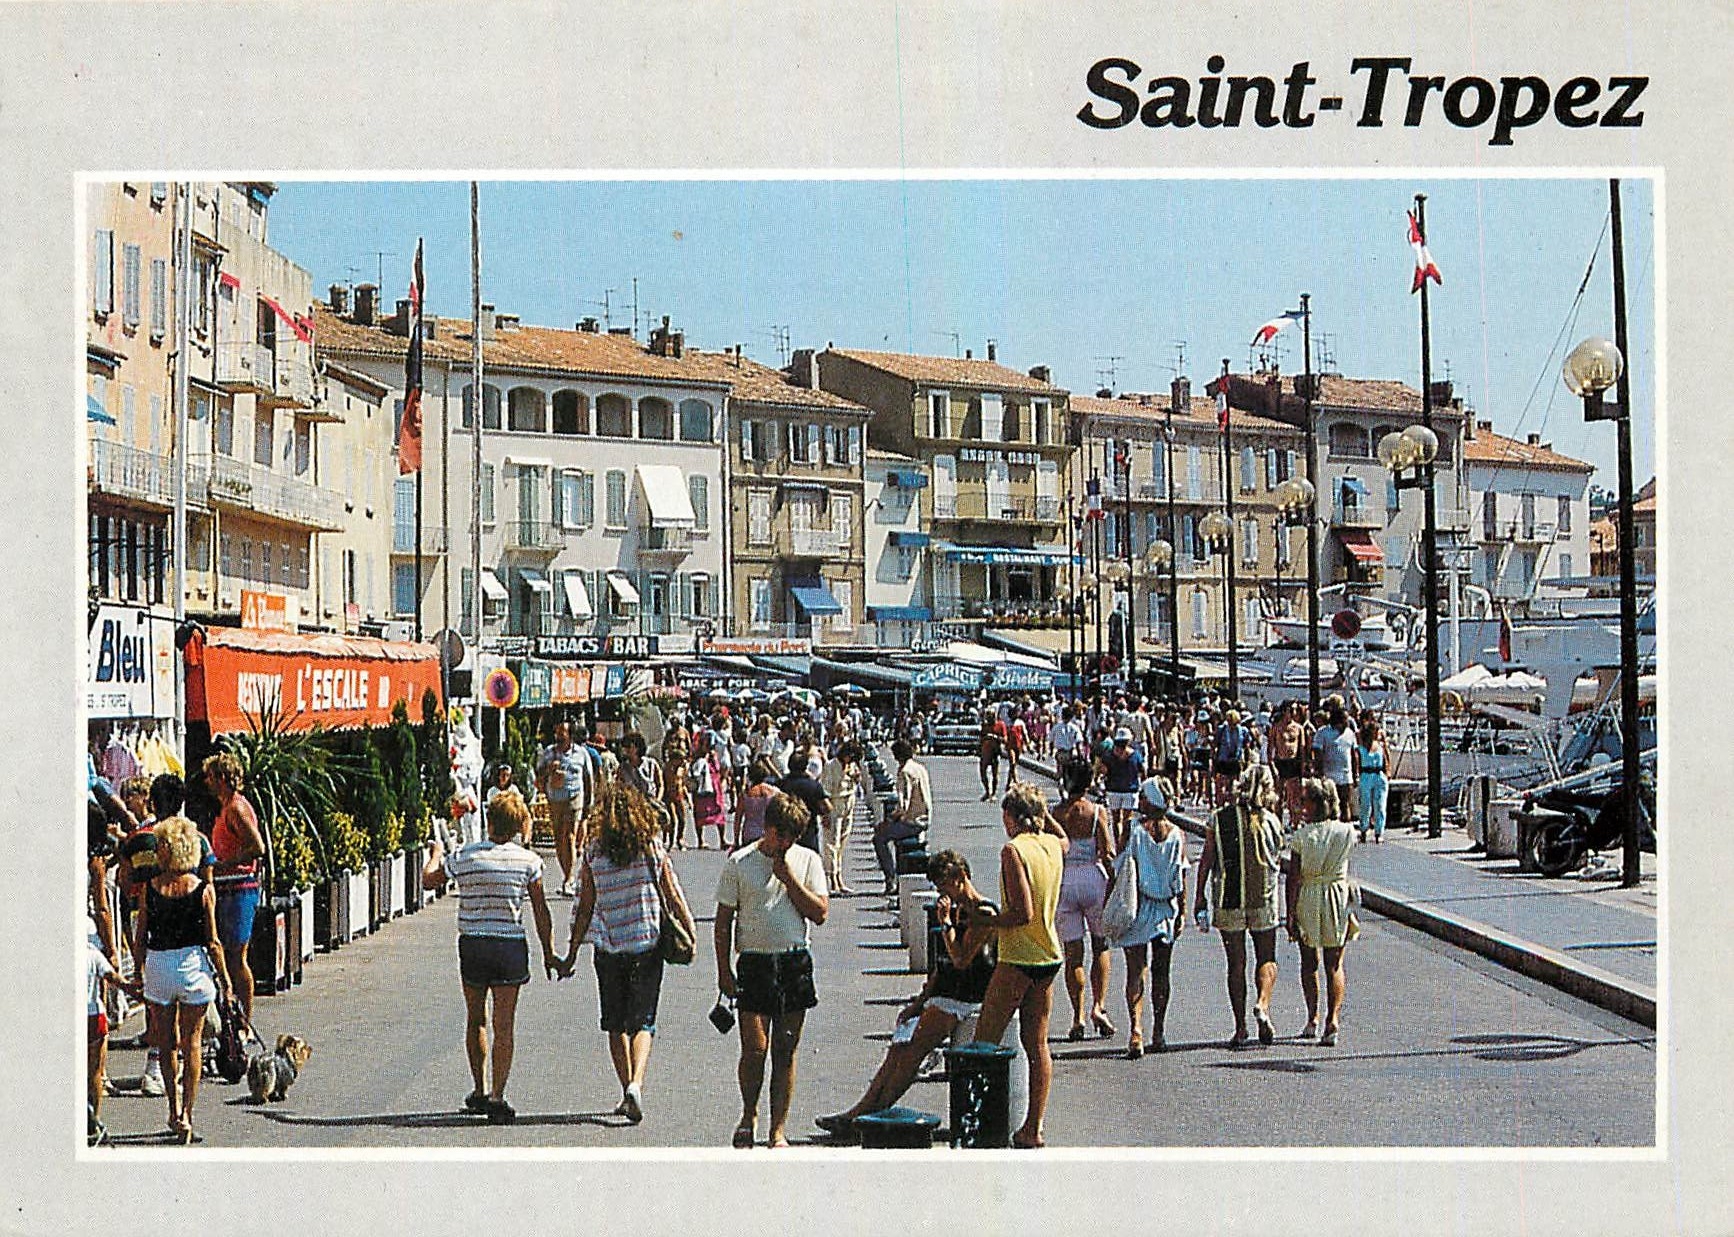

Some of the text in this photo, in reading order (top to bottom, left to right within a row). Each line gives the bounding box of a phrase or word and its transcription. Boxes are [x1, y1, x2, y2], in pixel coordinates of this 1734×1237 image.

[95, 619, 146, 684] Bleu
[538, 637, 600, 654] TABACS
[613, 637, 649, 654] BAR
[728, 679, 757, 688] PORT
[916, 664, 979, 685] CAPRICE
[296, 663, 369, 713] L'ESCALE
